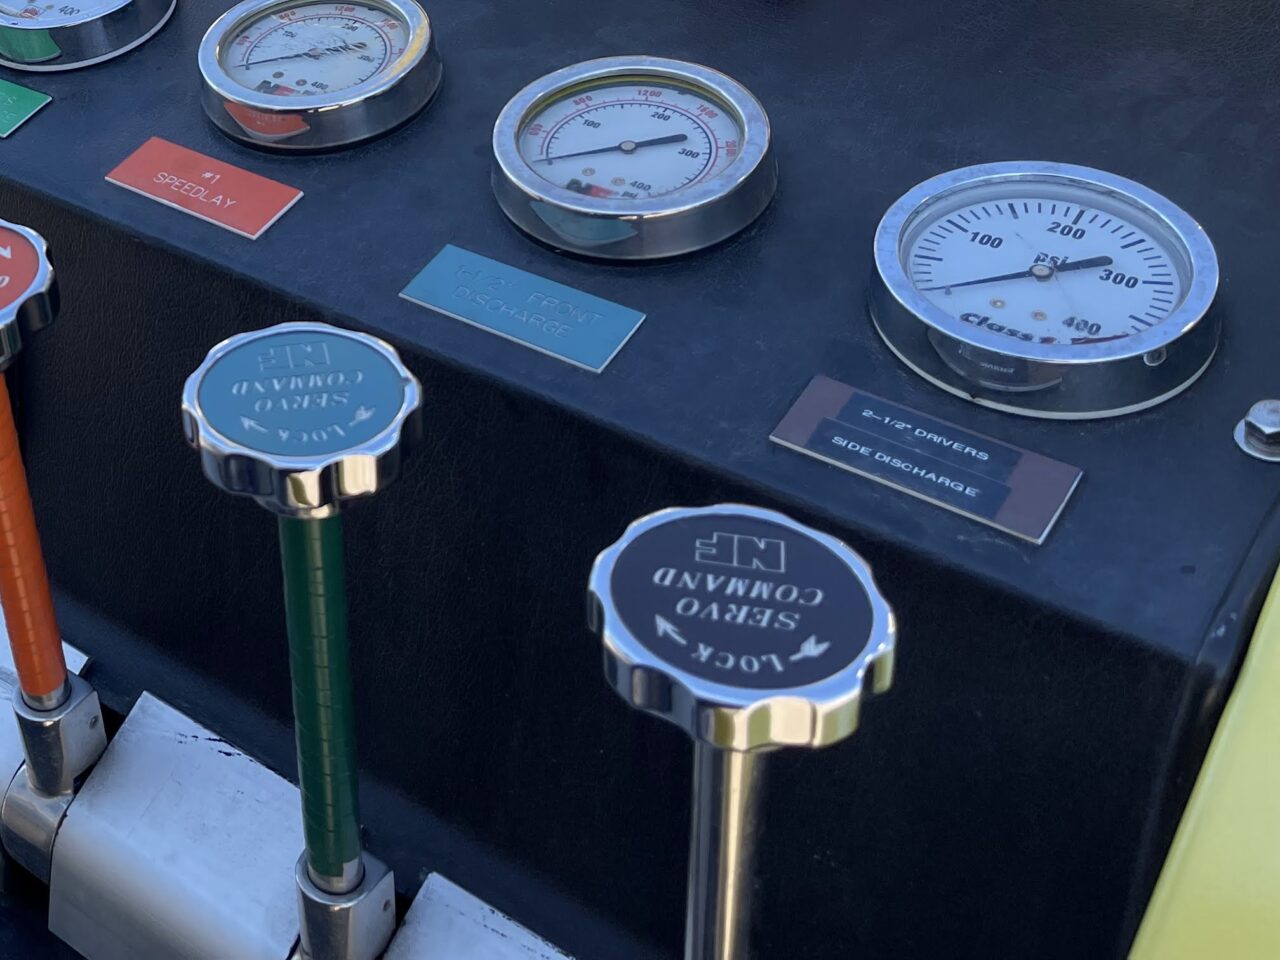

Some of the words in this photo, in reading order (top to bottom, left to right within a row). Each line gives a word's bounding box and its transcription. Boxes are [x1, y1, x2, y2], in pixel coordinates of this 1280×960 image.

[637, 89, 663, 98] 1200
[582, 119, 602, 129] 100
[650, 111, 671, 122] 200
[678, 148, 700, 159] 300
[201, 170, 221, 185] #1
[629, 180, 652, 191] 400
[153, 172, 237, 209] SPEEDLAY
[969, 230, 1004, 249] 100
[1046, 221, 1086, 240] 200
[1098, 269, 1139, 289] 300
[451, 286, 572, 338] DISCHARGE
[526, 292, 605, 325] FRONT
[1061, 316, 1103, 336] 400
[232, 370, 364, 395] COMMAND
[254, 392, 349, 411] SERVO
[277, 424, 346, 443] LOCK
[914, 427, 989, 462] DRIVERS
[831, 435, 871, 457] SIDE
[874, 446, 978, 497] DISCHARGE
[695, 531, 786, 573] NF
[653, 567, 823, 606] COMMAND
[676, 596, 801, 631] SERVO
[691, 642, 784, 672] LOCK
